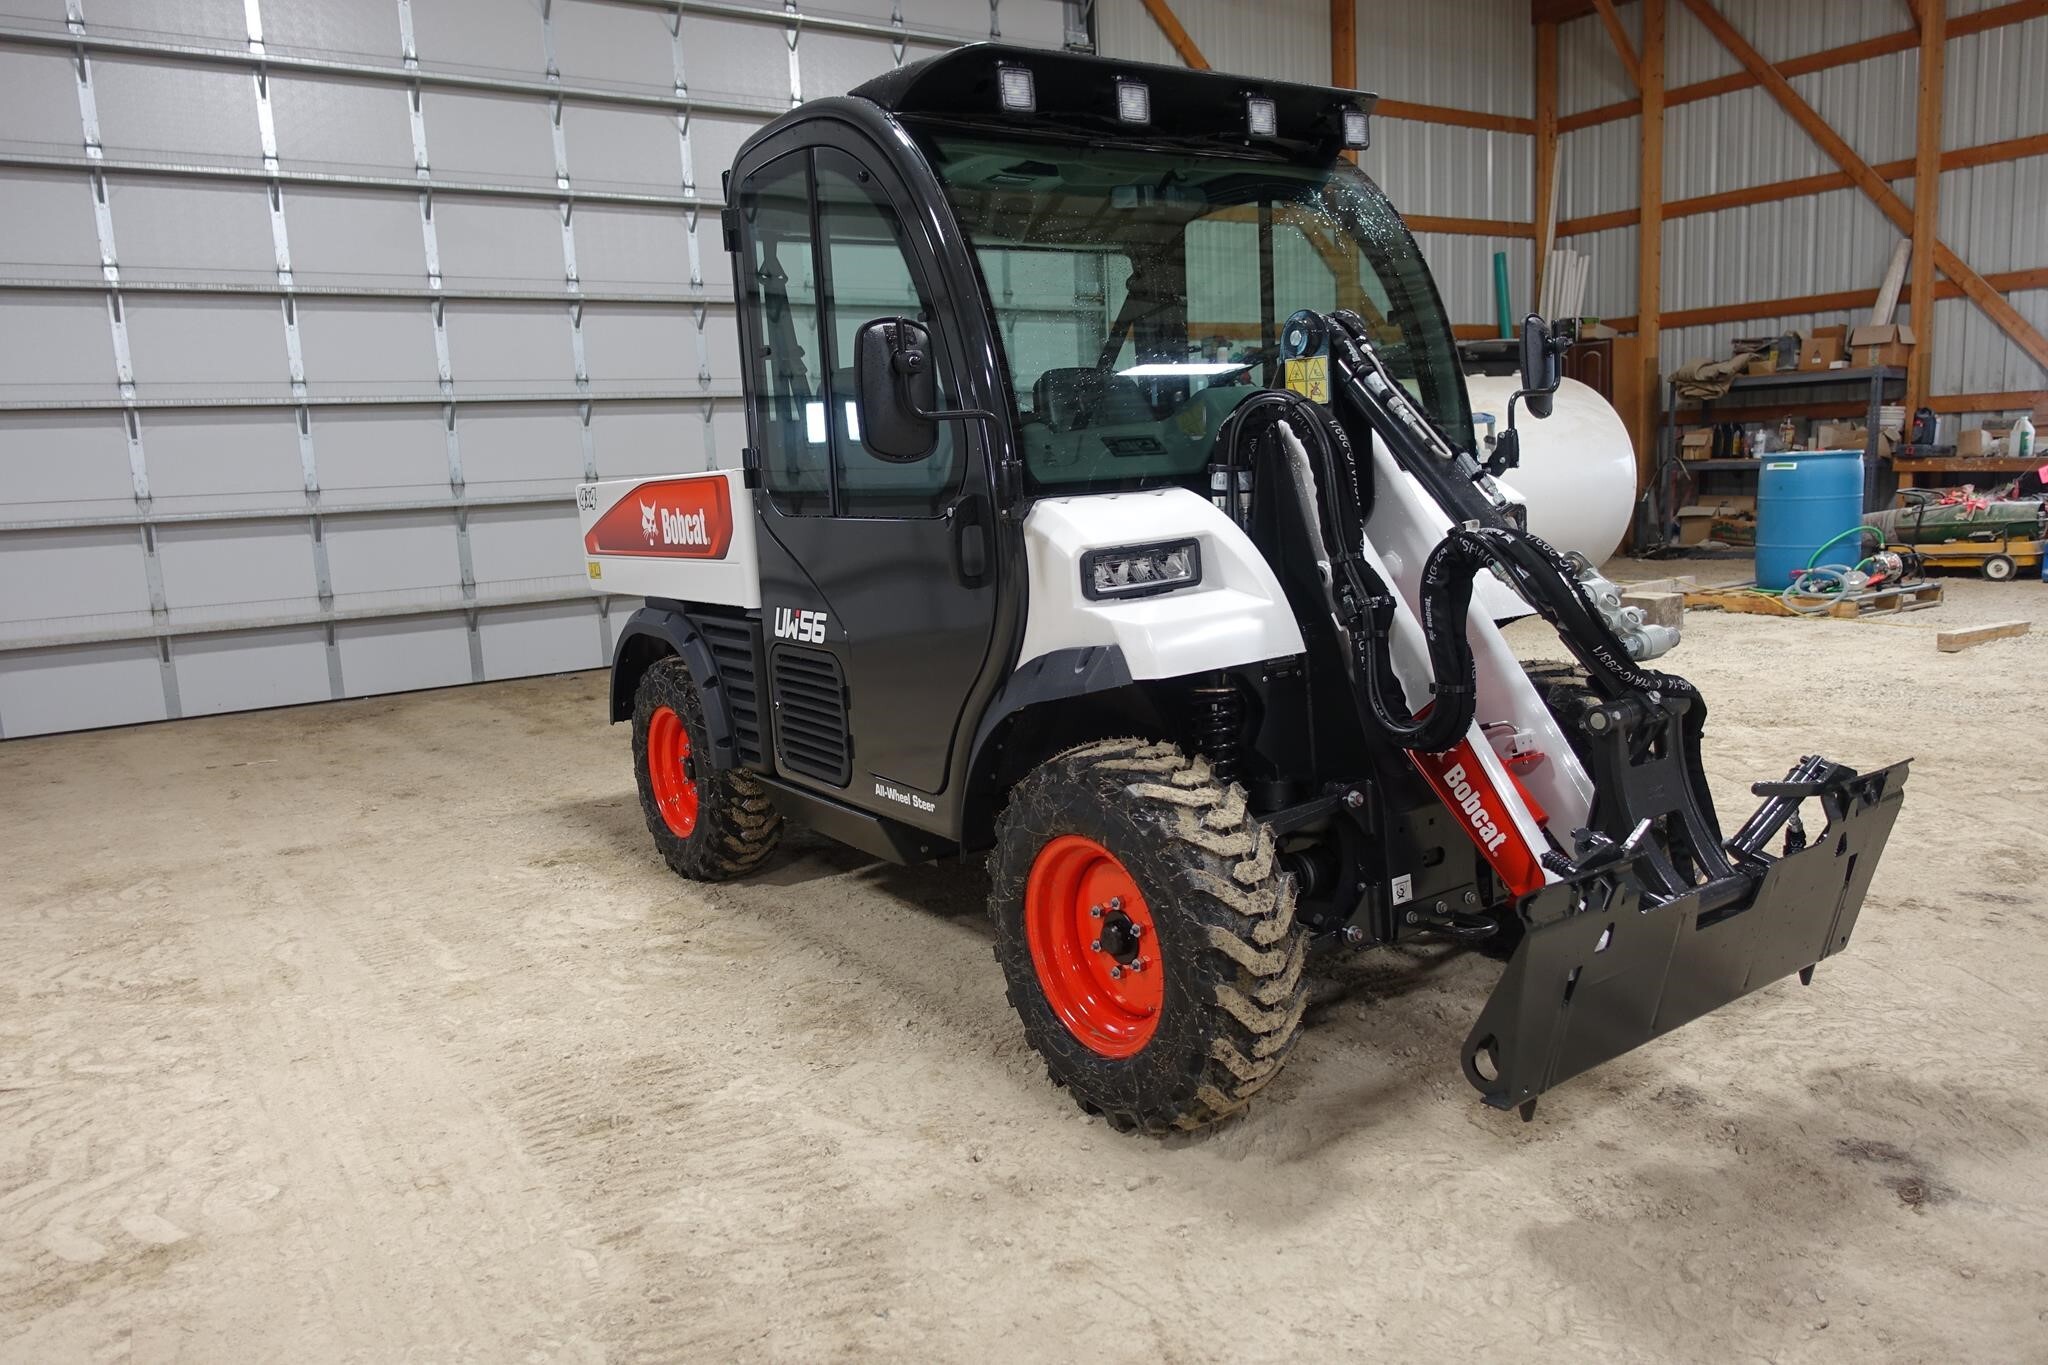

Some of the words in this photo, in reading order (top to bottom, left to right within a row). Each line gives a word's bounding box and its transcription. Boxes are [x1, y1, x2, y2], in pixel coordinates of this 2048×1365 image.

[661, 507, 707, 545] Bobcat
[875, 783, 911, 805] All-Wheel
[912, 794, 936, 812] Steer
[1443, 763, 1507, 853] Bobcat
